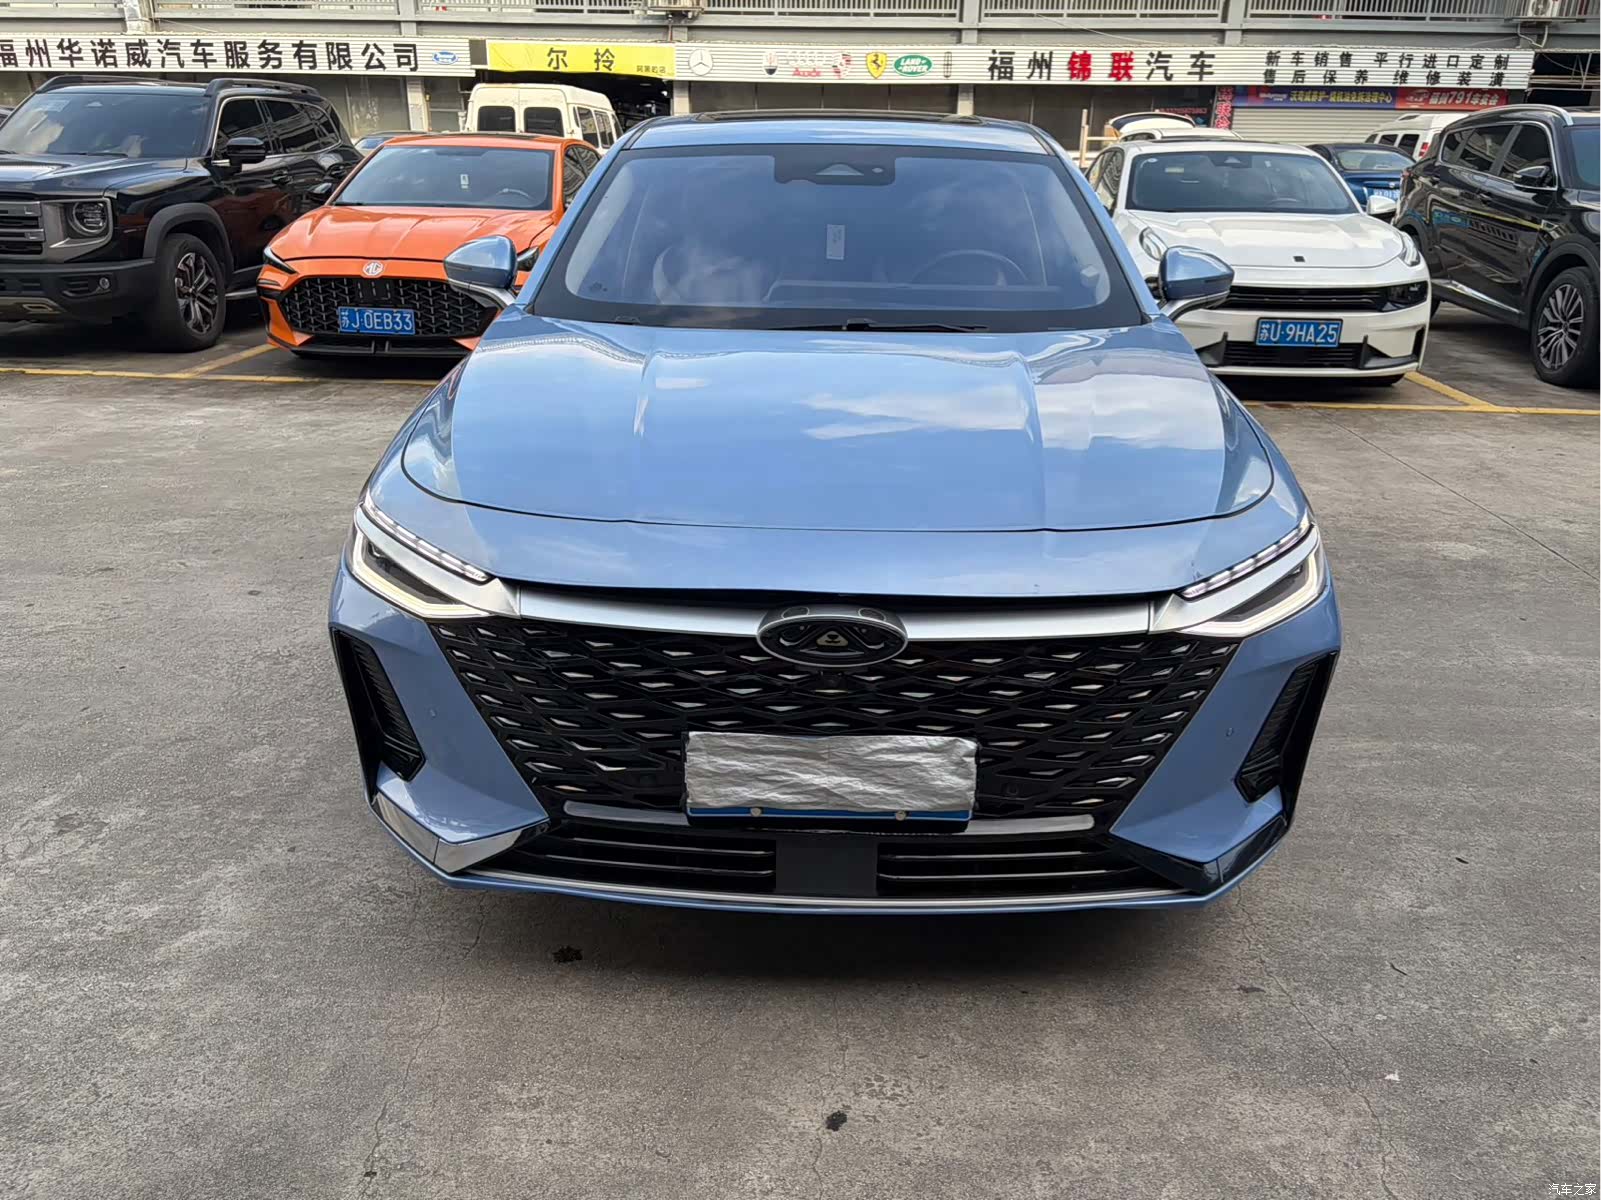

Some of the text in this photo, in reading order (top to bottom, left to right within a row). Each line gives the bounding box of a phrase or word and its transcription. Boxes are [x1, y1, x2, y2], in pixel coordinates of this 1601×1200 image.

[547, 47, 616, 72] 尔拎
[900, 58, 922, 66] LAND
[902, 65, 929, 73] ROVER
[988, 49, 1216, 82] 福州锦联汽车
[1265, 50, 1510, 70] 新车销售 平行进口定制
[1263, 69, 1504, 88] 售后保养 维修装潢
